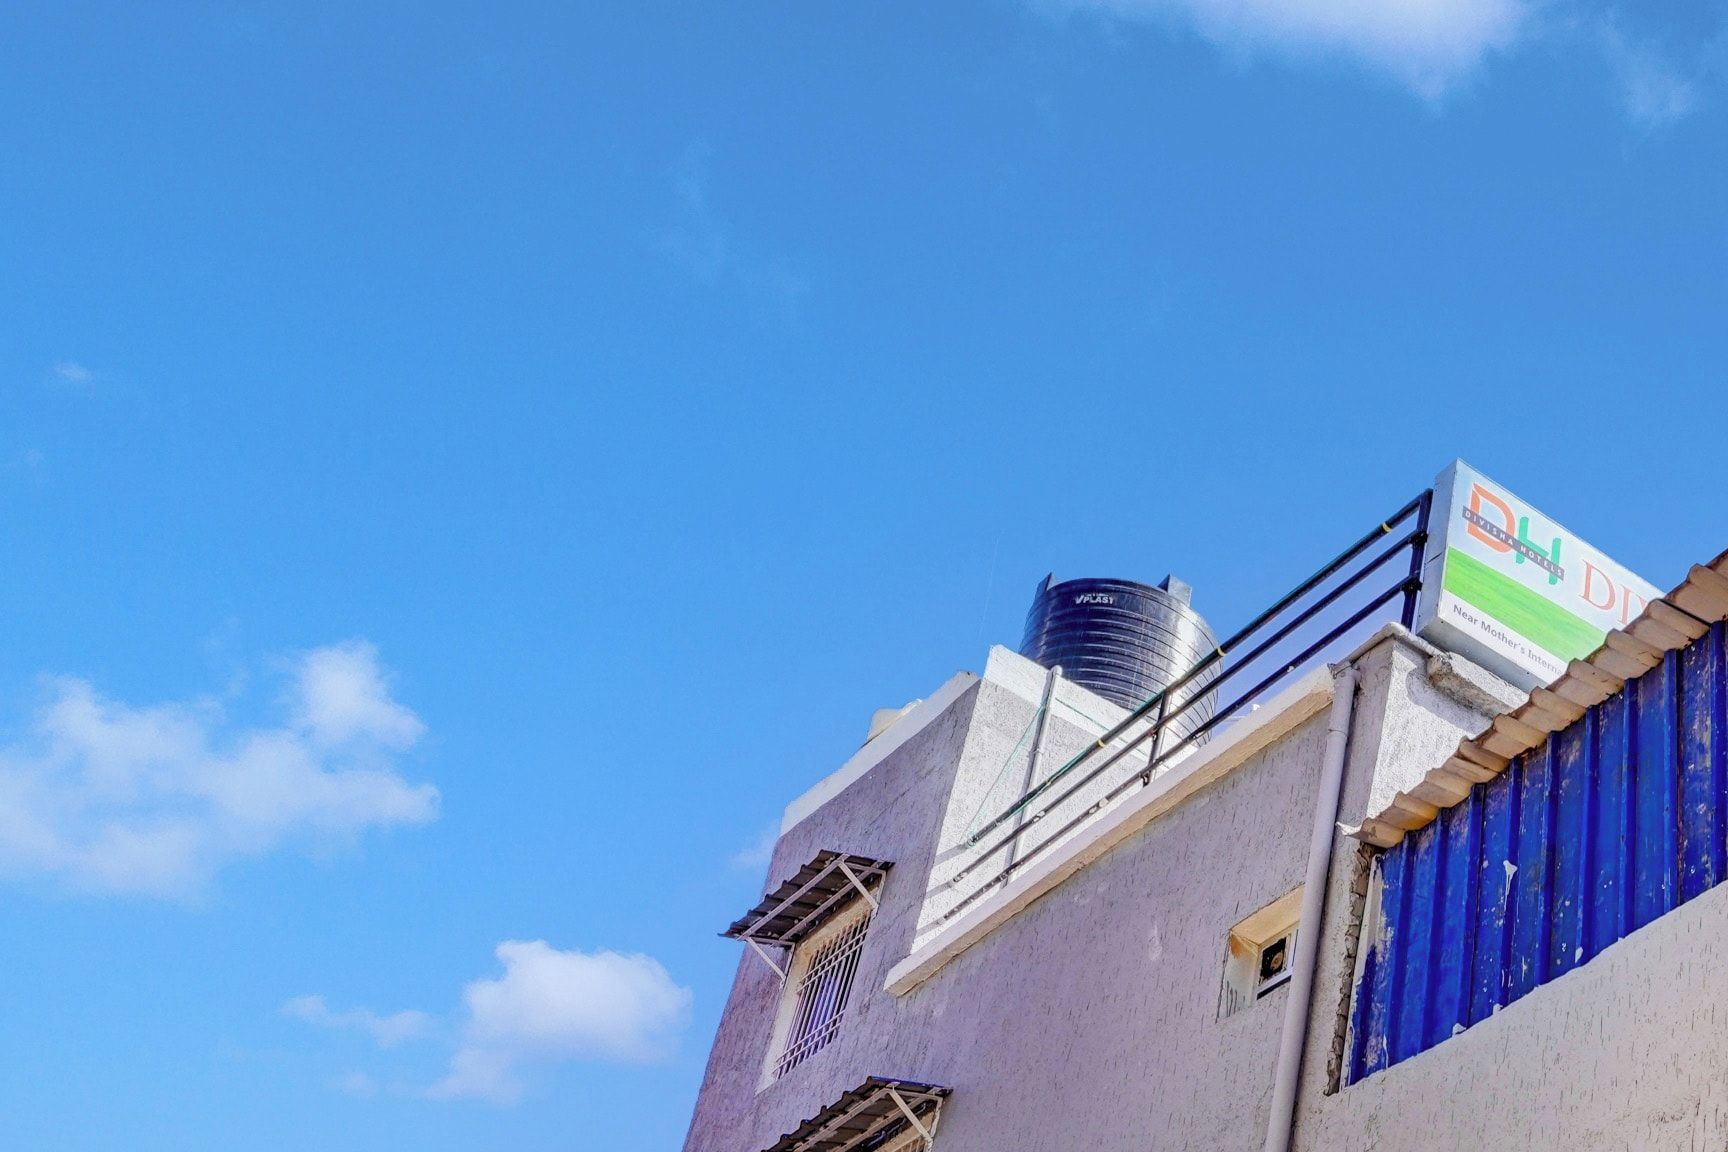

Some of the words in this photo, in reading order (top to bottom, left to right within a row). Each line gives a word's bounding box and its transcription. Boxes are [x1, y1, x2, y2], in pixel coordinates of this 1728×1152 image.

[1464, 509, 1514, 546] DIVISHA
[1519, 545, 1563, 577] HOTELS
[1578, 559, 1647, 625] DI
[1453, 603, 1479, 625] Near
[1480, 620, 1526, 654] Mother's
